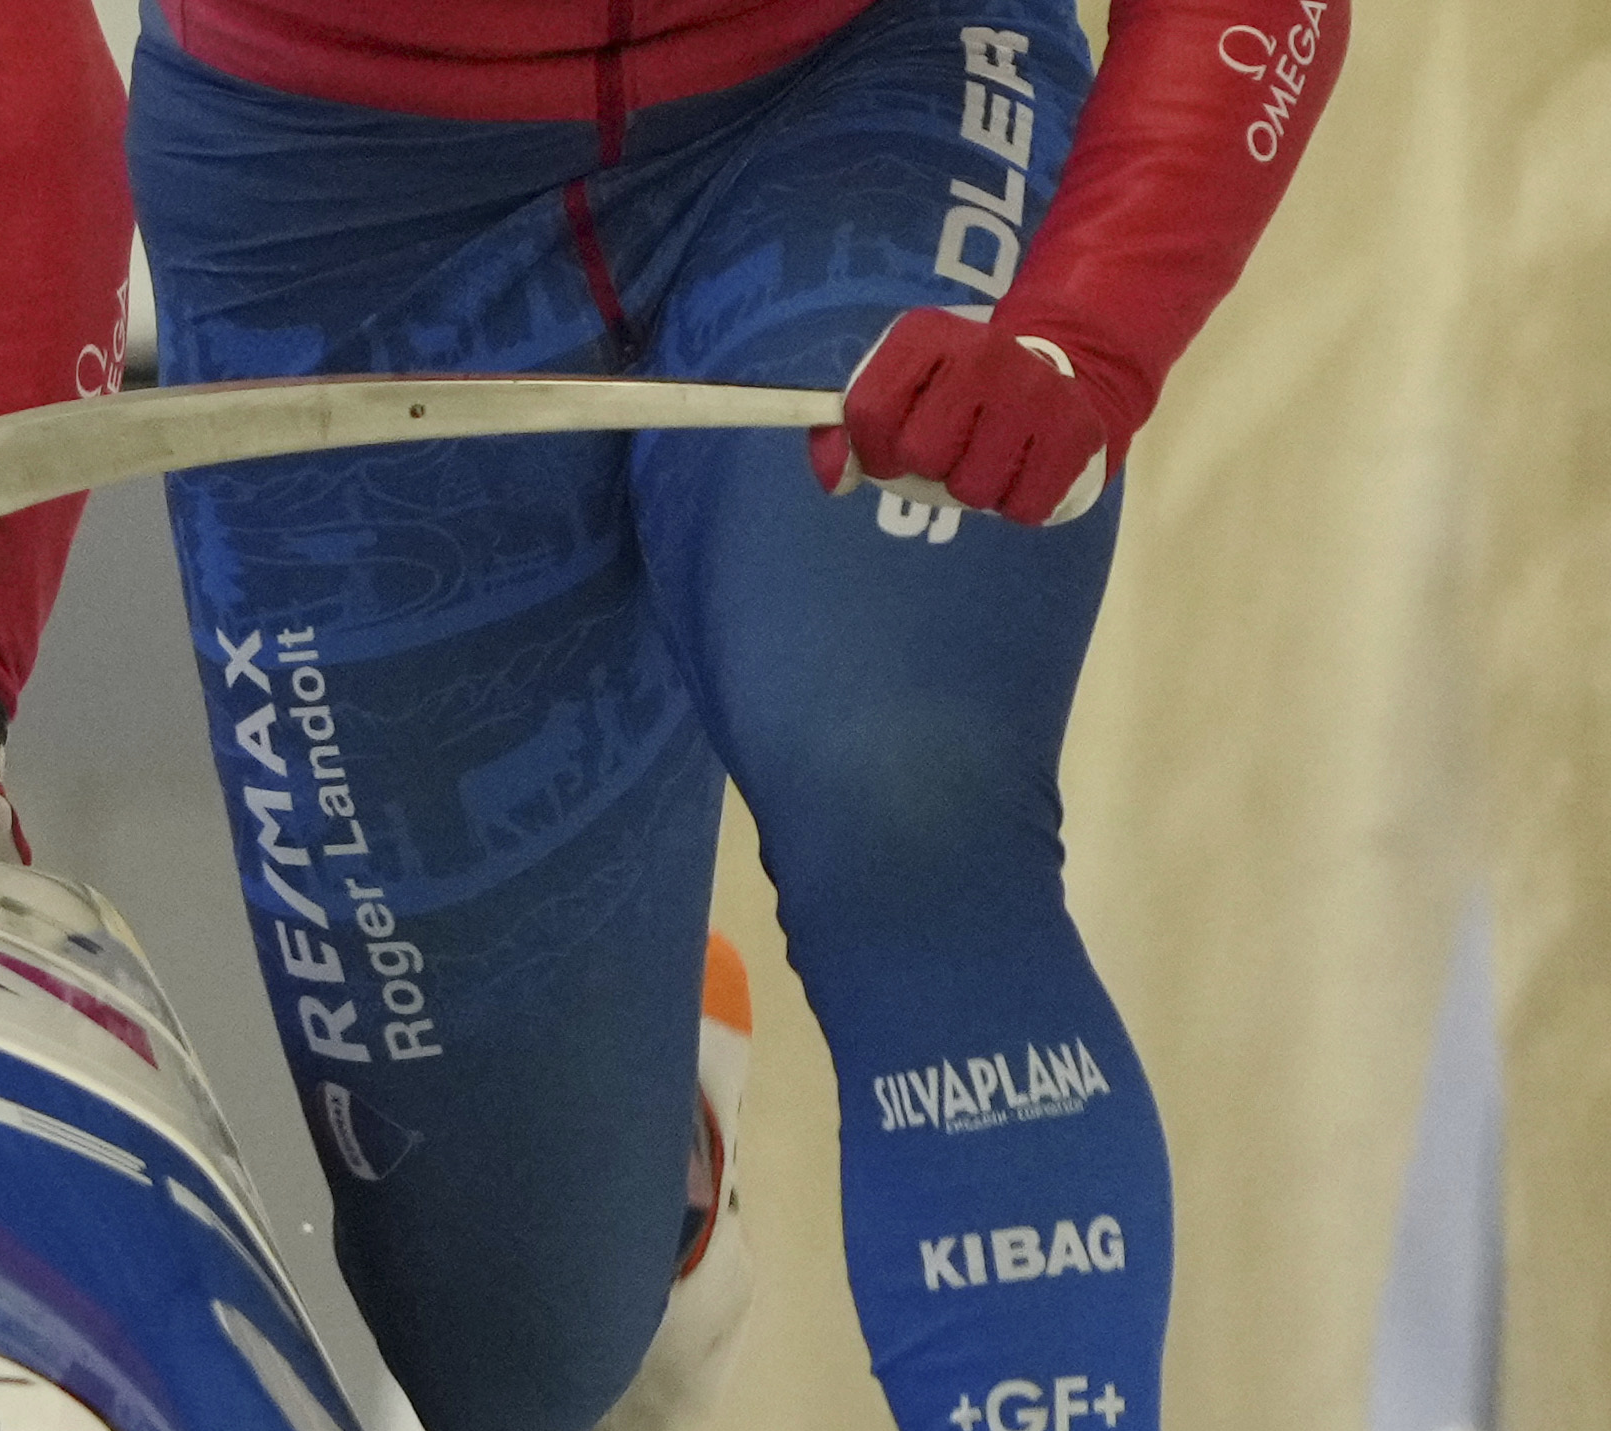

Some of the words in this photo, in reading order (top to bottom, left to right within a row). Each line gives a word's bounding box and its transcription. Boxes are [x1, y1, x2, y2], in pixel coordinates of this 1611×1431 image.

[1246, 0, 1327, 162] OMEGA
[277, 625, 370, 856] Landolt
[215, 626, 373, 1063] RE/MAX
[345, 877, 444, 1062] Roger
[875, 1036, 1111, 1132] SILVAPLANA
[919, 1214, 1126, 1292] KIBAG
